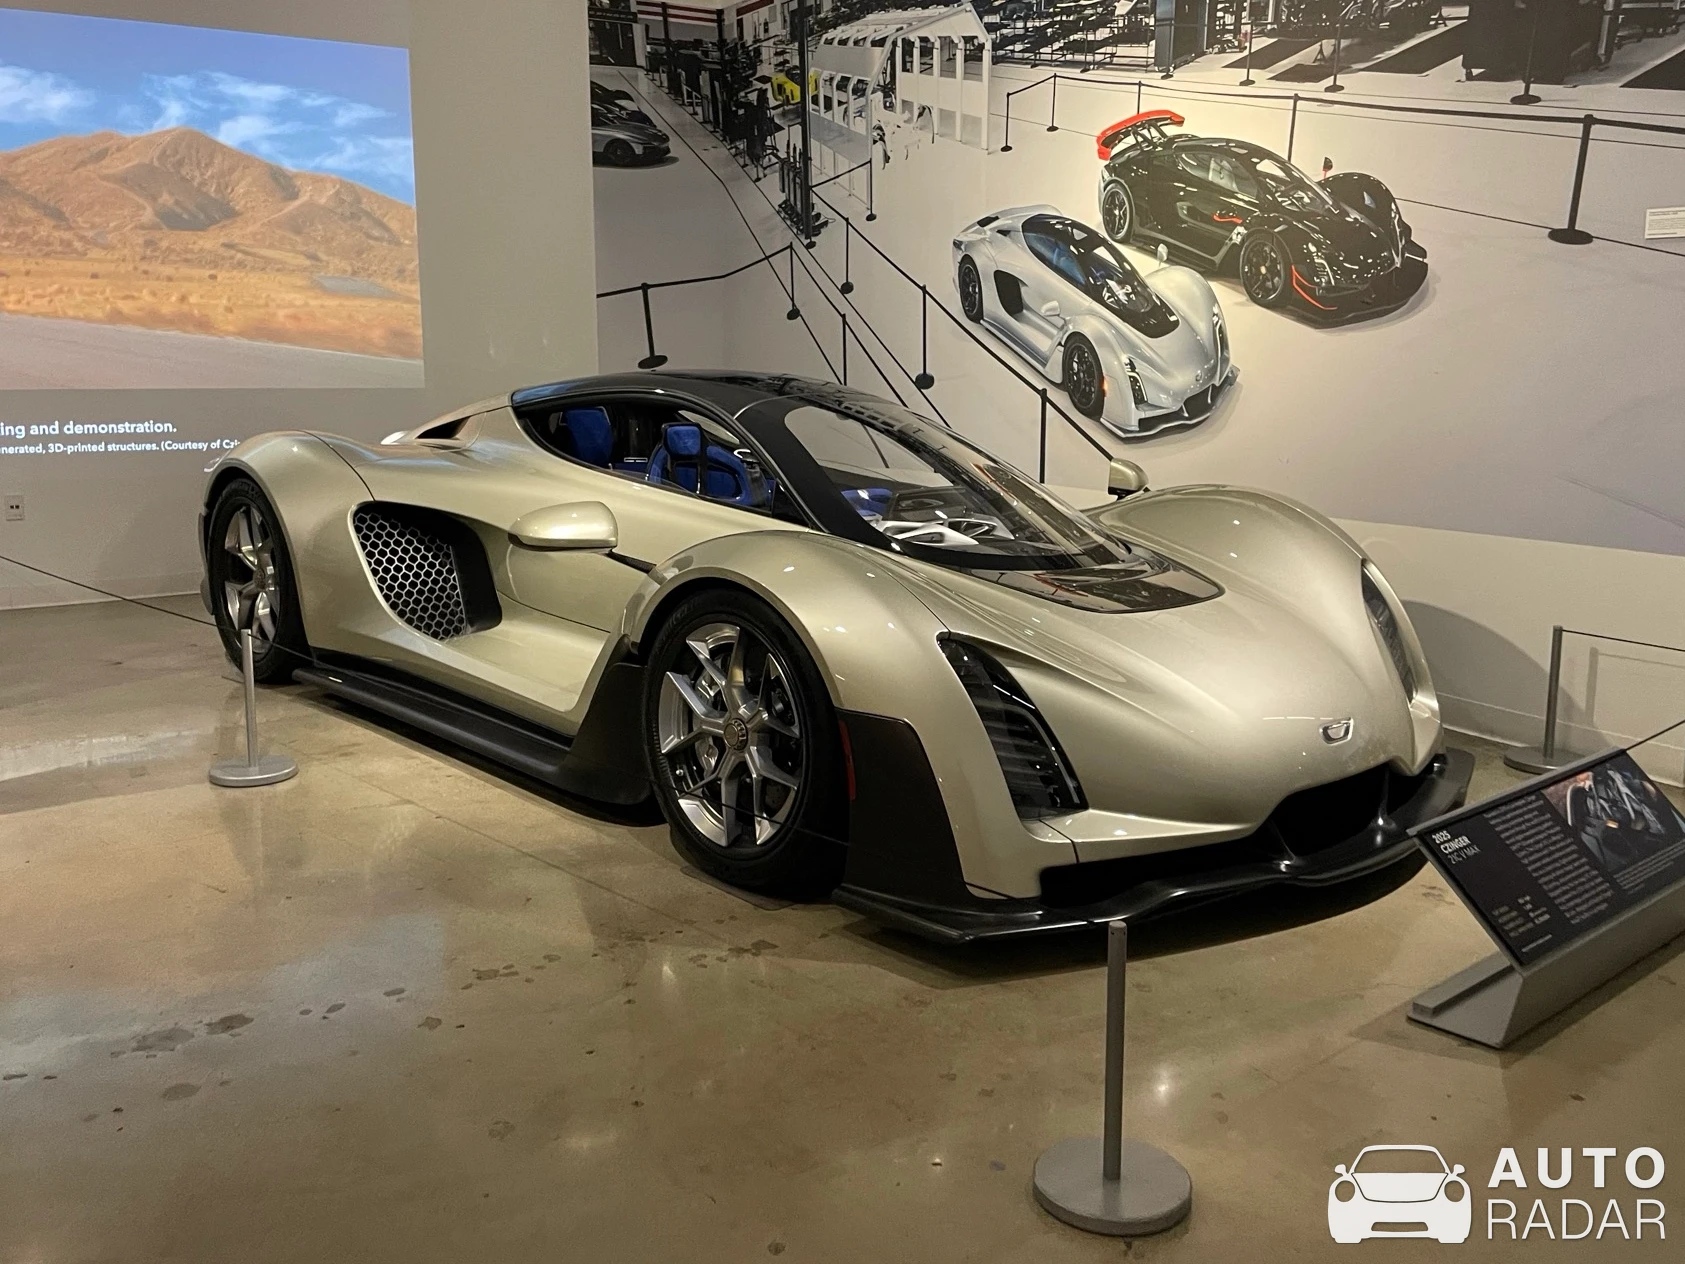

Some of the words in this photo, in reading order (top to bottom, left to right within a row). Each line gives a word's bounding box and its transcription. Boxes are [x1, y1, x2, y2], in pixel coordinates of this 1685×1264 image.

[0, 422, 26, 439] ing
[30, 420, 59, 435] and
[63, 419, 177, 435] demonstration.
[0, 443, 46, 454] nerated,
[47, 441, 105, 455] 3D-printed
[107, 442, 160, 452] structures.
[160, 440, 208, 452] (Courtesy
[210, 439, 221, 449] of
[1431, 830, 1451, 844] 2025
[1440, 835, 1471, 854] CZINGER
